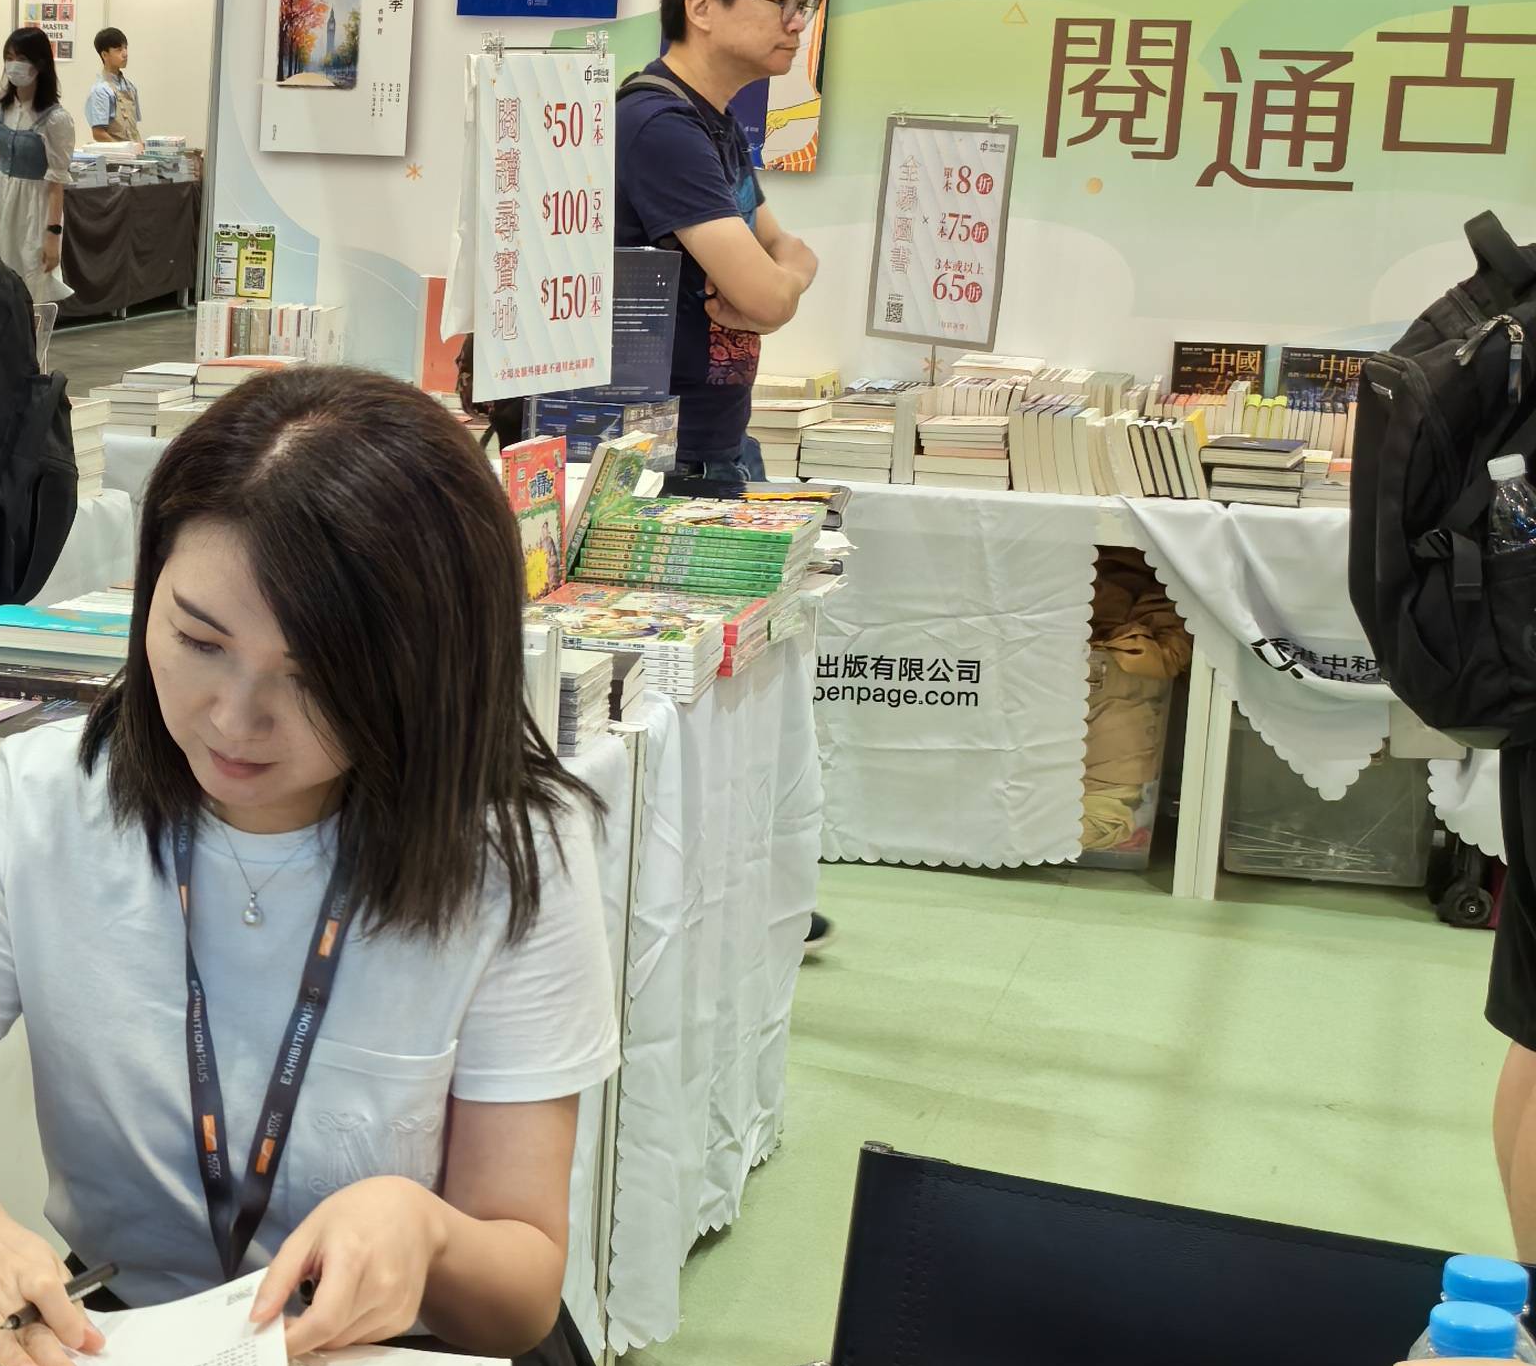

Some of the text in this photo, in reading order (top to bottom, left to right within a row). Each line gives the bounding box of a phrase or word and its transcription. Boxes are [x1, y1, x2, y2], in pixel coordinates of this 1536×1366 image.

[544, 102, 583, 148] $50
[542, 189, 588, 235] $100
[541, 273, 587, 322] $150
[1211, 348, 1262, 375] 中國
[816, 654, 981, 684] 出版有限公司
